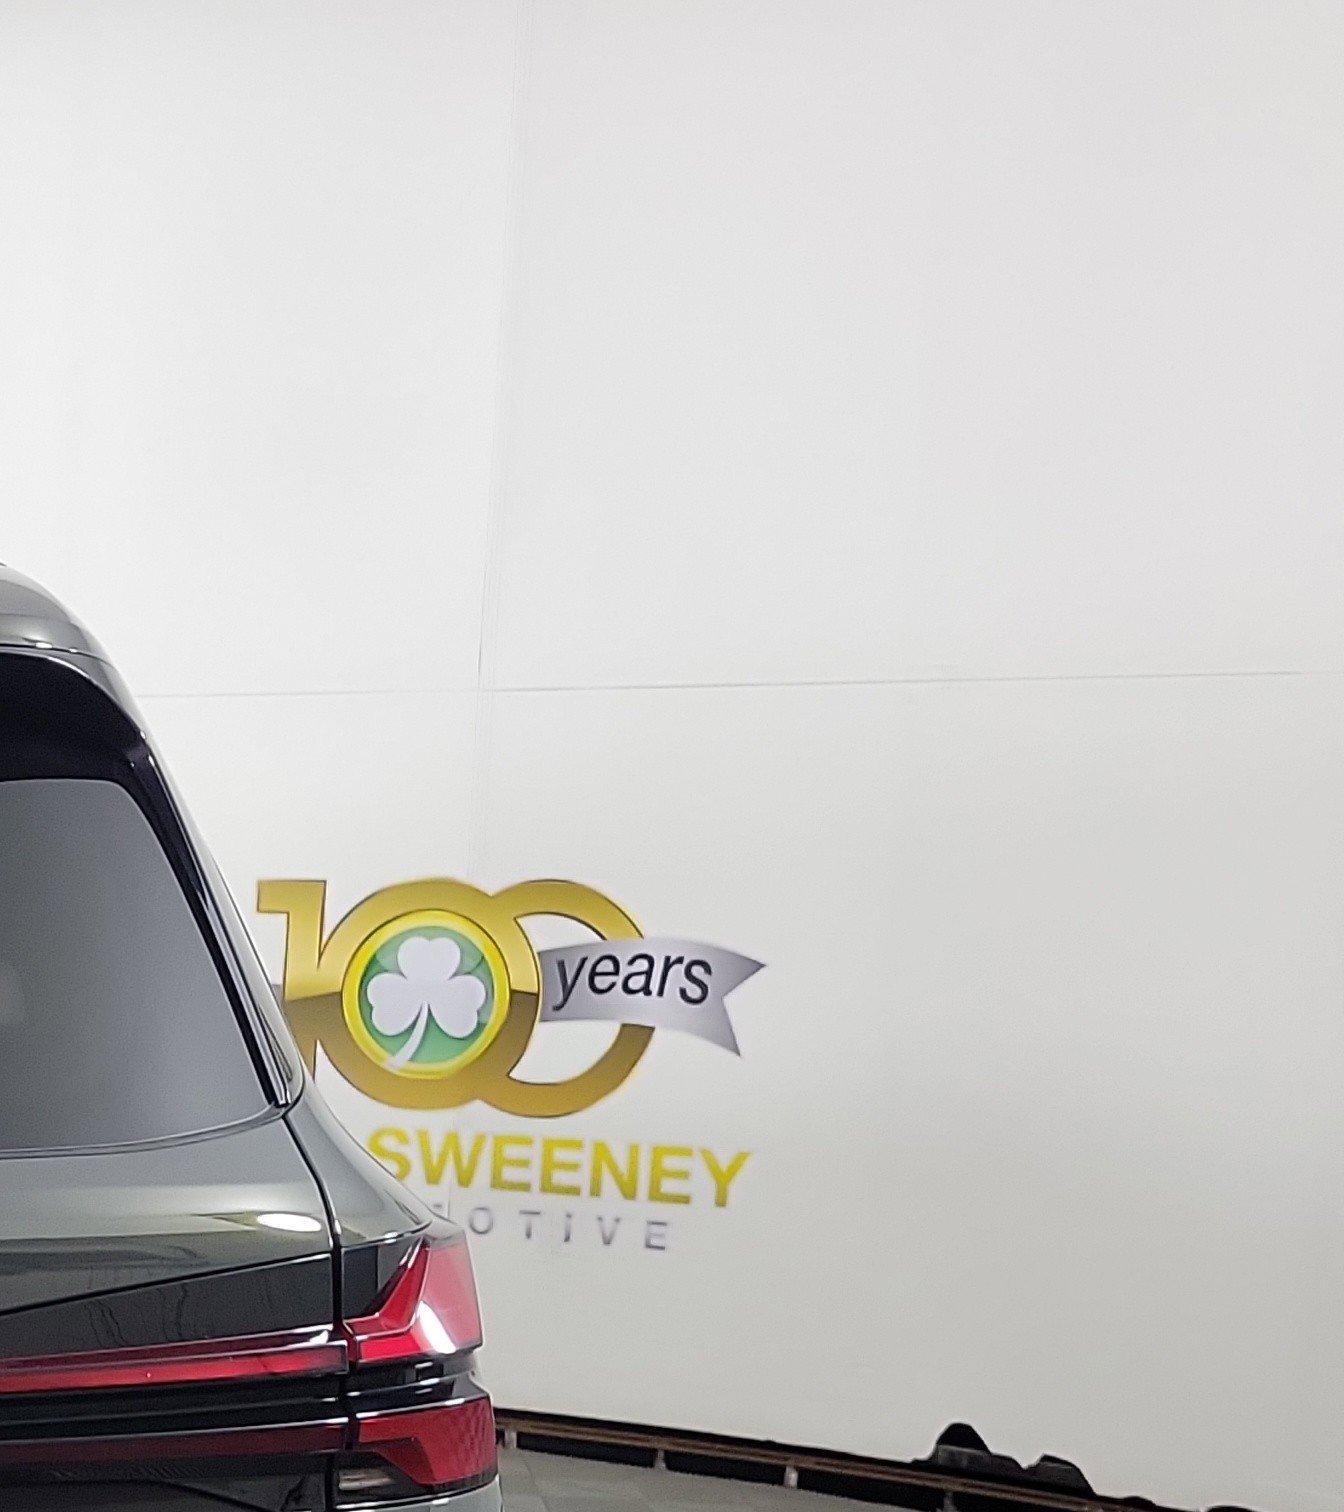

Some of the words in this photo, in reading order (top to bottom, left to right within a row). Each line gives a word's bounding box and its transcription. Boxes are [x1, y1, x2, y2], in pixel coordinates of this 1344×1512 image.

[257, 879, 655, 1118] 100
[552, 953, 714, 1011] years
[367, 1127, 751, 1207] SWEENEY
